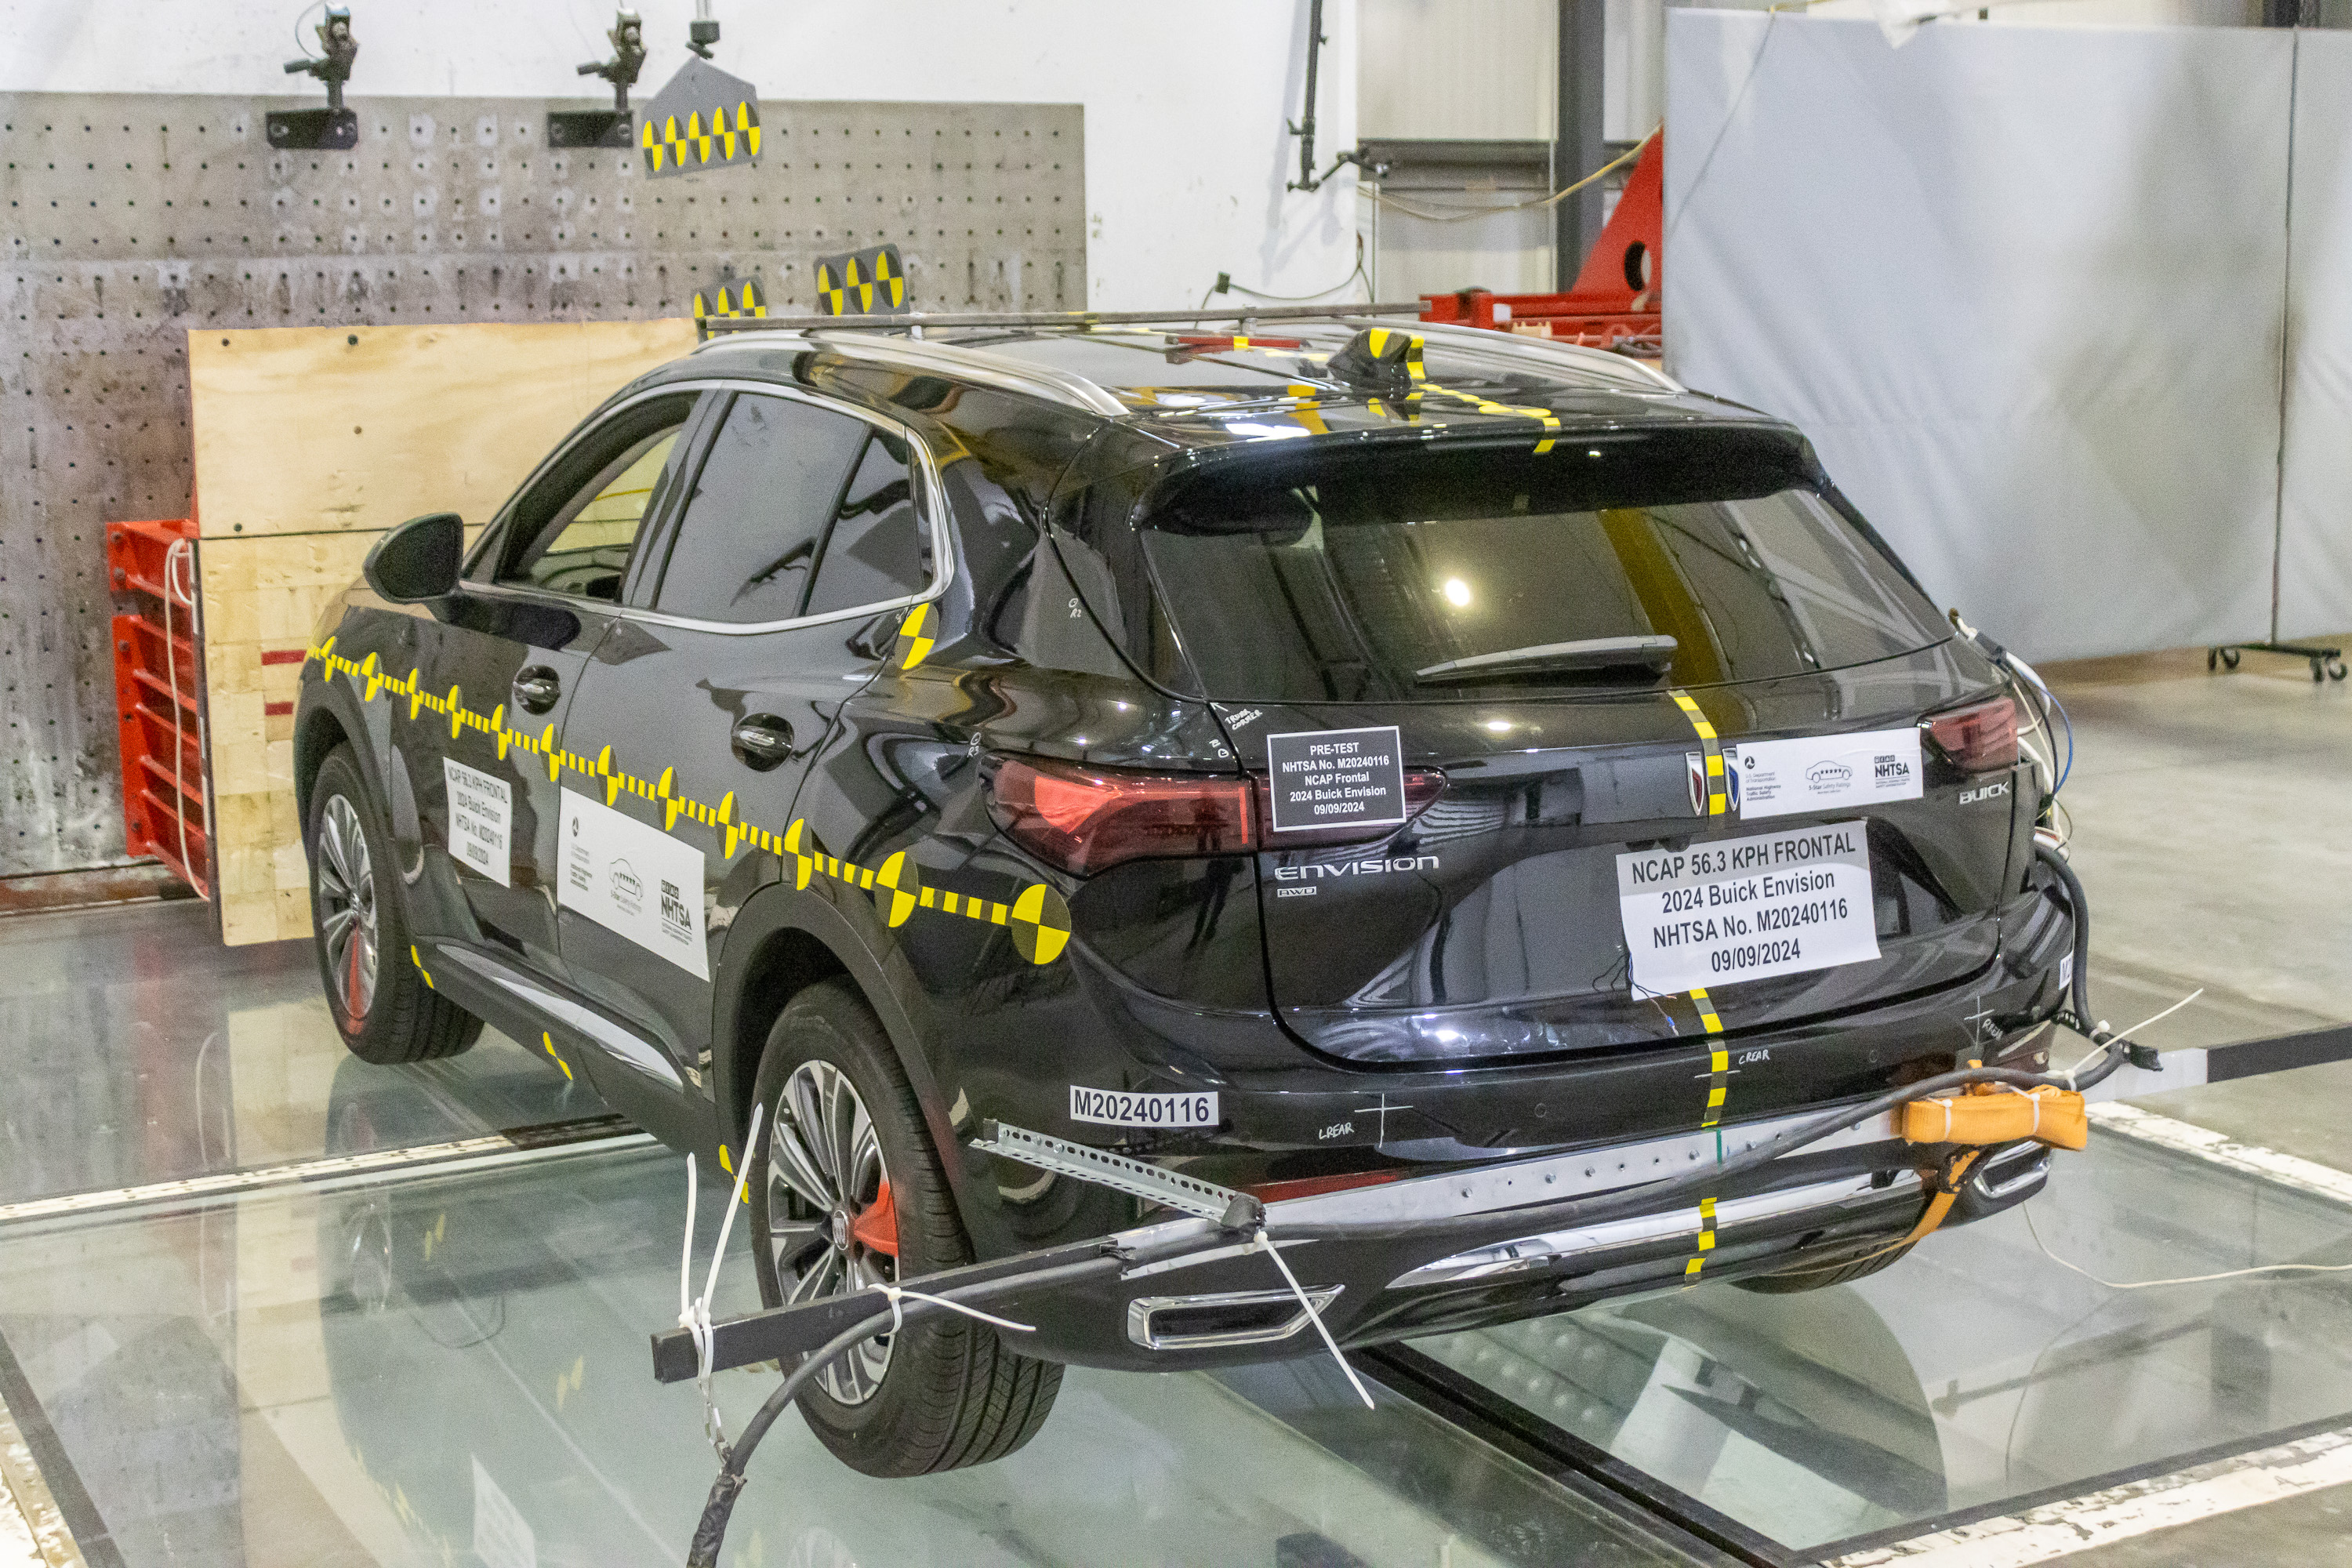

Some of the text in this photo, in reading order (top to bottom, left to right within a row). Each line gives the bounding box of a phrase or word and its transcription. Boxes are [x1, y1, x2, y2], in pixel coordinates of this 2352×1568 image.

[1310, 742, 1359, 755] PRE-TEST
[1282, 755, 1389, 772] NHTSA No. M20240116
[1875, 761, 1910, 778] NHTSA
[1305, 771, 1370, 786] NCAP Frontal
[1290, 786, 1386, 802] 2024 Buick Envision
[1959, 781, 2009, 804] BUICK
[1314, 801, 1365, 815] 09/09/2024
[1274, 855, 1439, 880] ENVISION
[1632, 832, 1856, 884] NCAP 56.3 KPH FRONTAL
[1279, 887, 1315, 896] AWD
[1661, 870, 1835, 913] 2024 Buick Envision
[661, 894, 692, 930] NHTSA
[1653, 898, 1848, 949] NHTSA No. M20240116
[1711, 938, 1801, 972] 09/09/2024
[1074, 1088, 1209, 1123] M20240116
